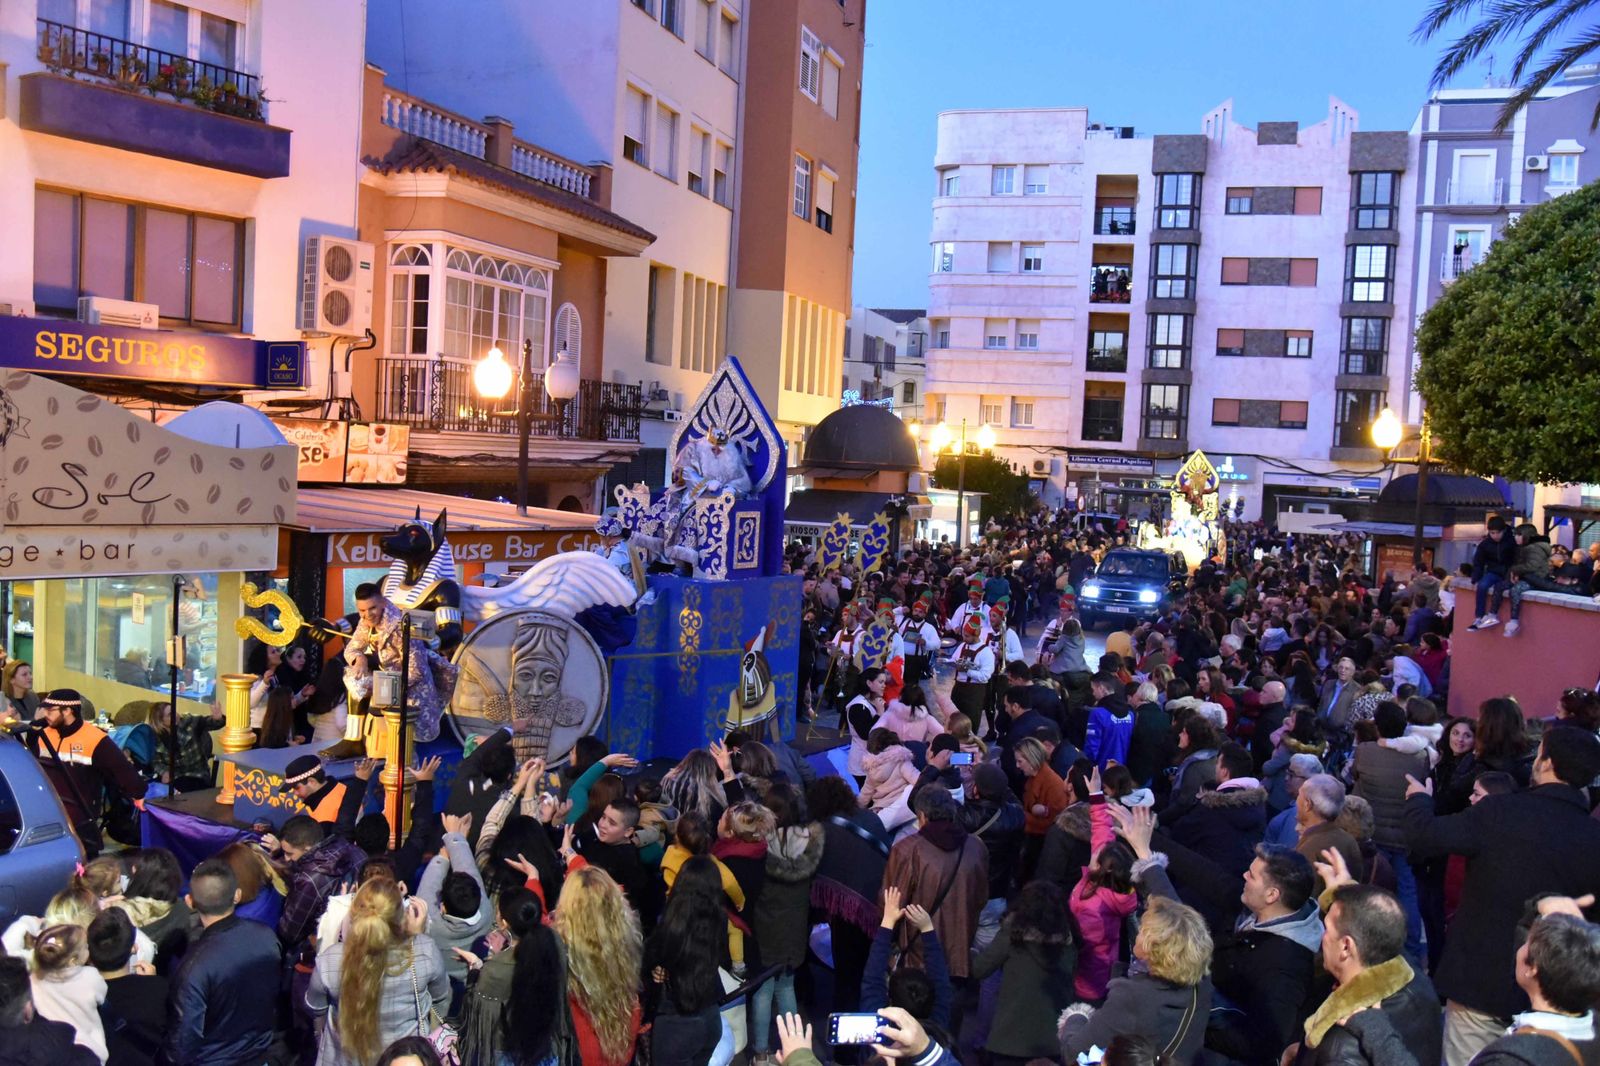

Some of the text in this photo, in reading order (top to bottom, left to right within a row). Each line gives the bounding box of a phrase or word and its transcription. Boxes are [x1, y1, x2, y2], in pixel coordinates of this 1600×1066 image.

[35, 330, 206, 370] SEGUROS
[32, 462, 172, 510] Sol
[790, 525, 819, 536] KIOSCO
[80, 539, 135, 561] bar
[505, 535, 545, 560] Bar
